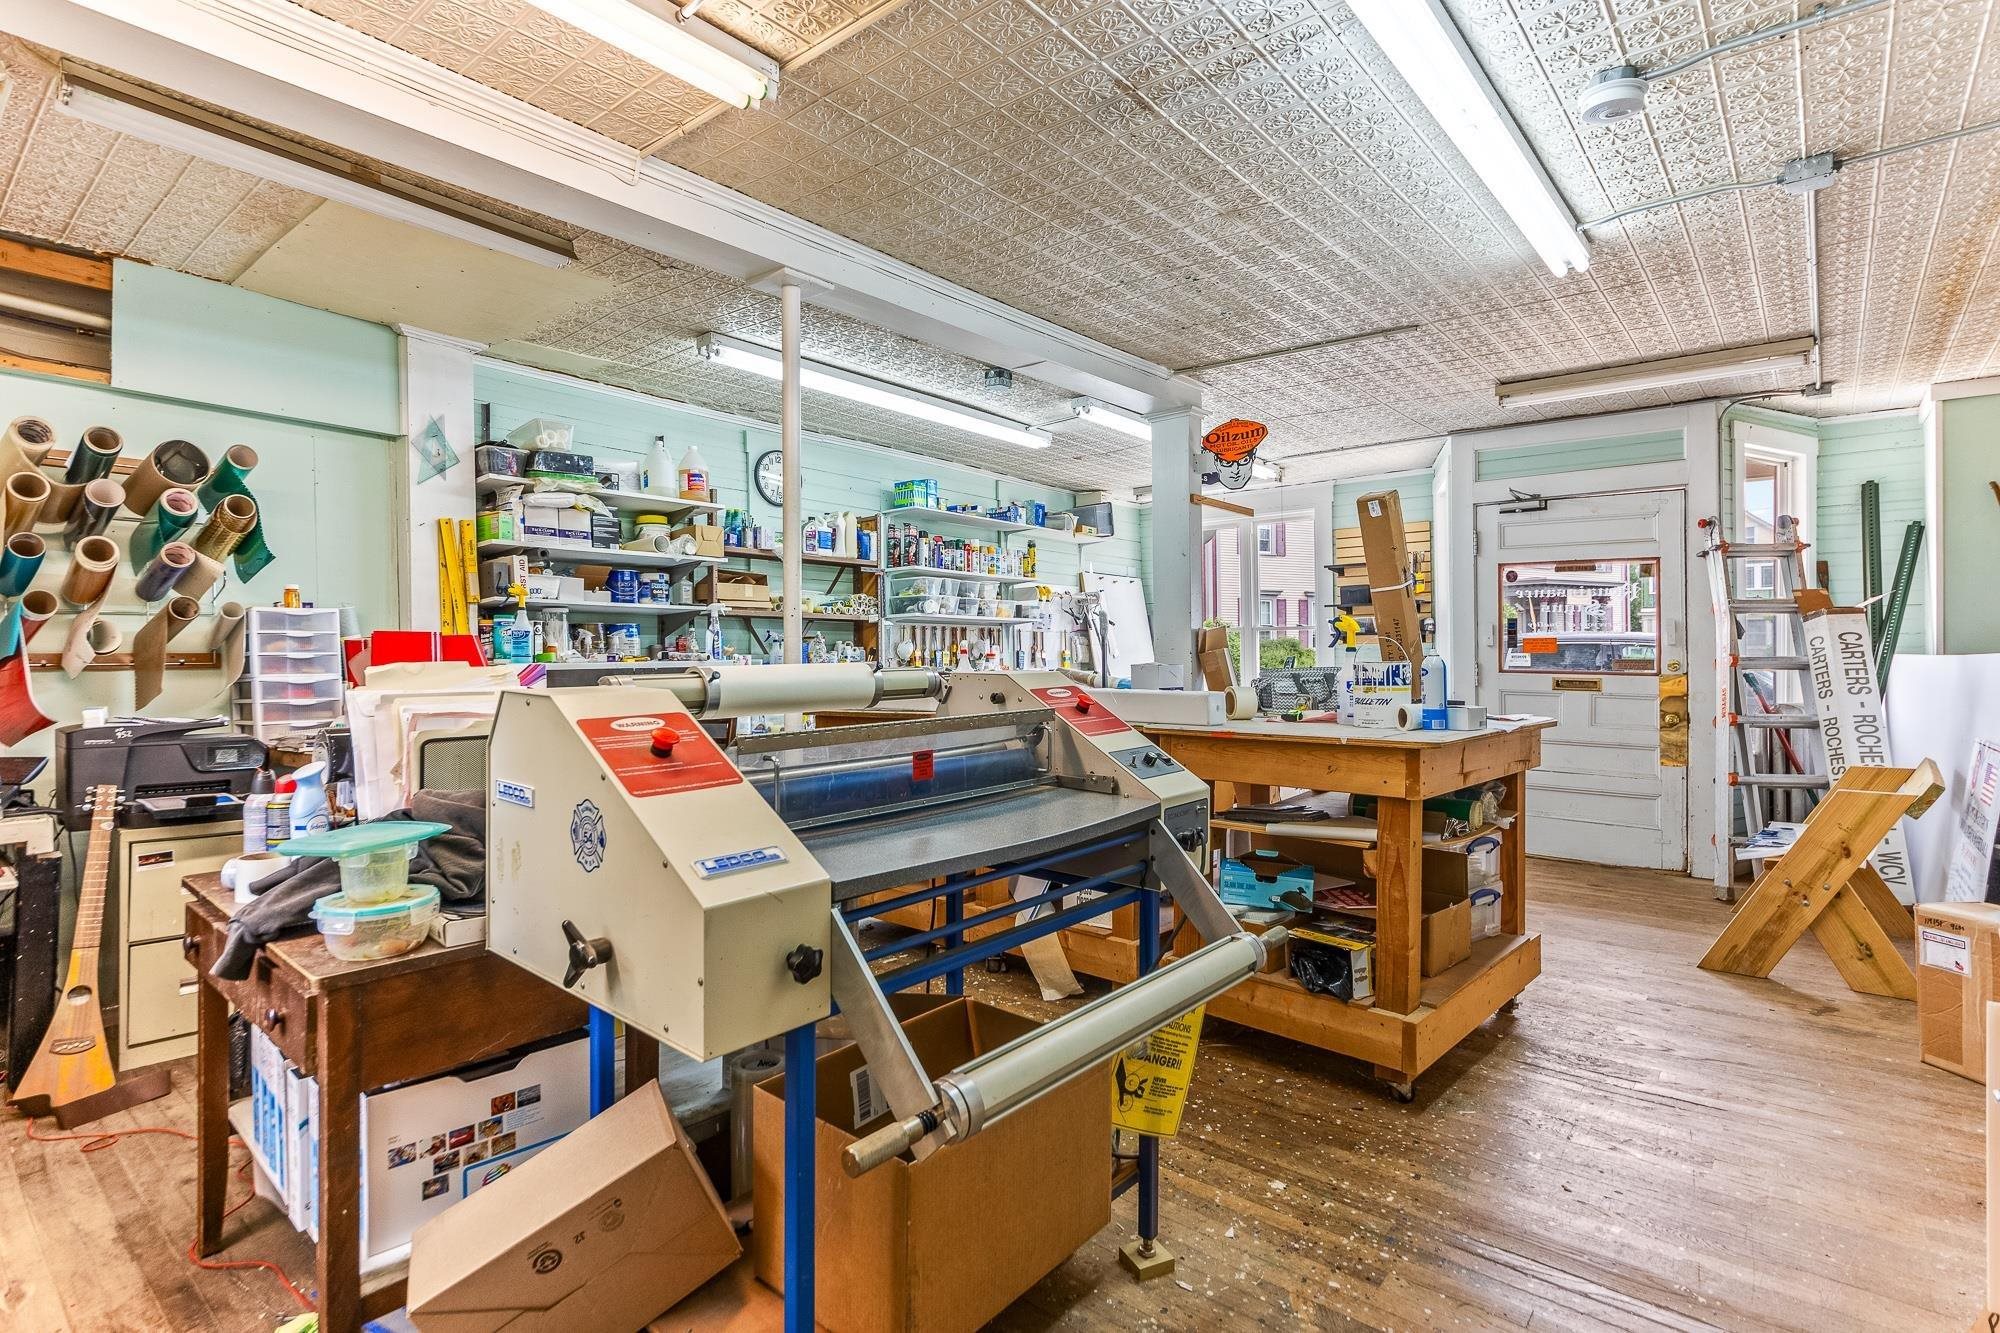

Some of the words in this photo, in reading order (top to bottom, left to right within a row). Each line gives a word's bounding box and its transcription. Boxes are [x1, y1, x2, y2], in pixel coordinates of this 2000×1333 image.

[1205, 426, 1266, 444] Oilzum
[518, 559, 526, 571] AID
[519, 574, 527, 588] RST
[1837, 631, 1872, 696] CARTERS
[1354, 697, 1393, 706] BULLETIN
[1809, 636, 1833, 700] CARTERS
[1823, 716, 1847, 782] ROCHES
[1853, 714, 1885, 768] ROCHE
[701, 850, 767, 871] LEDCO
